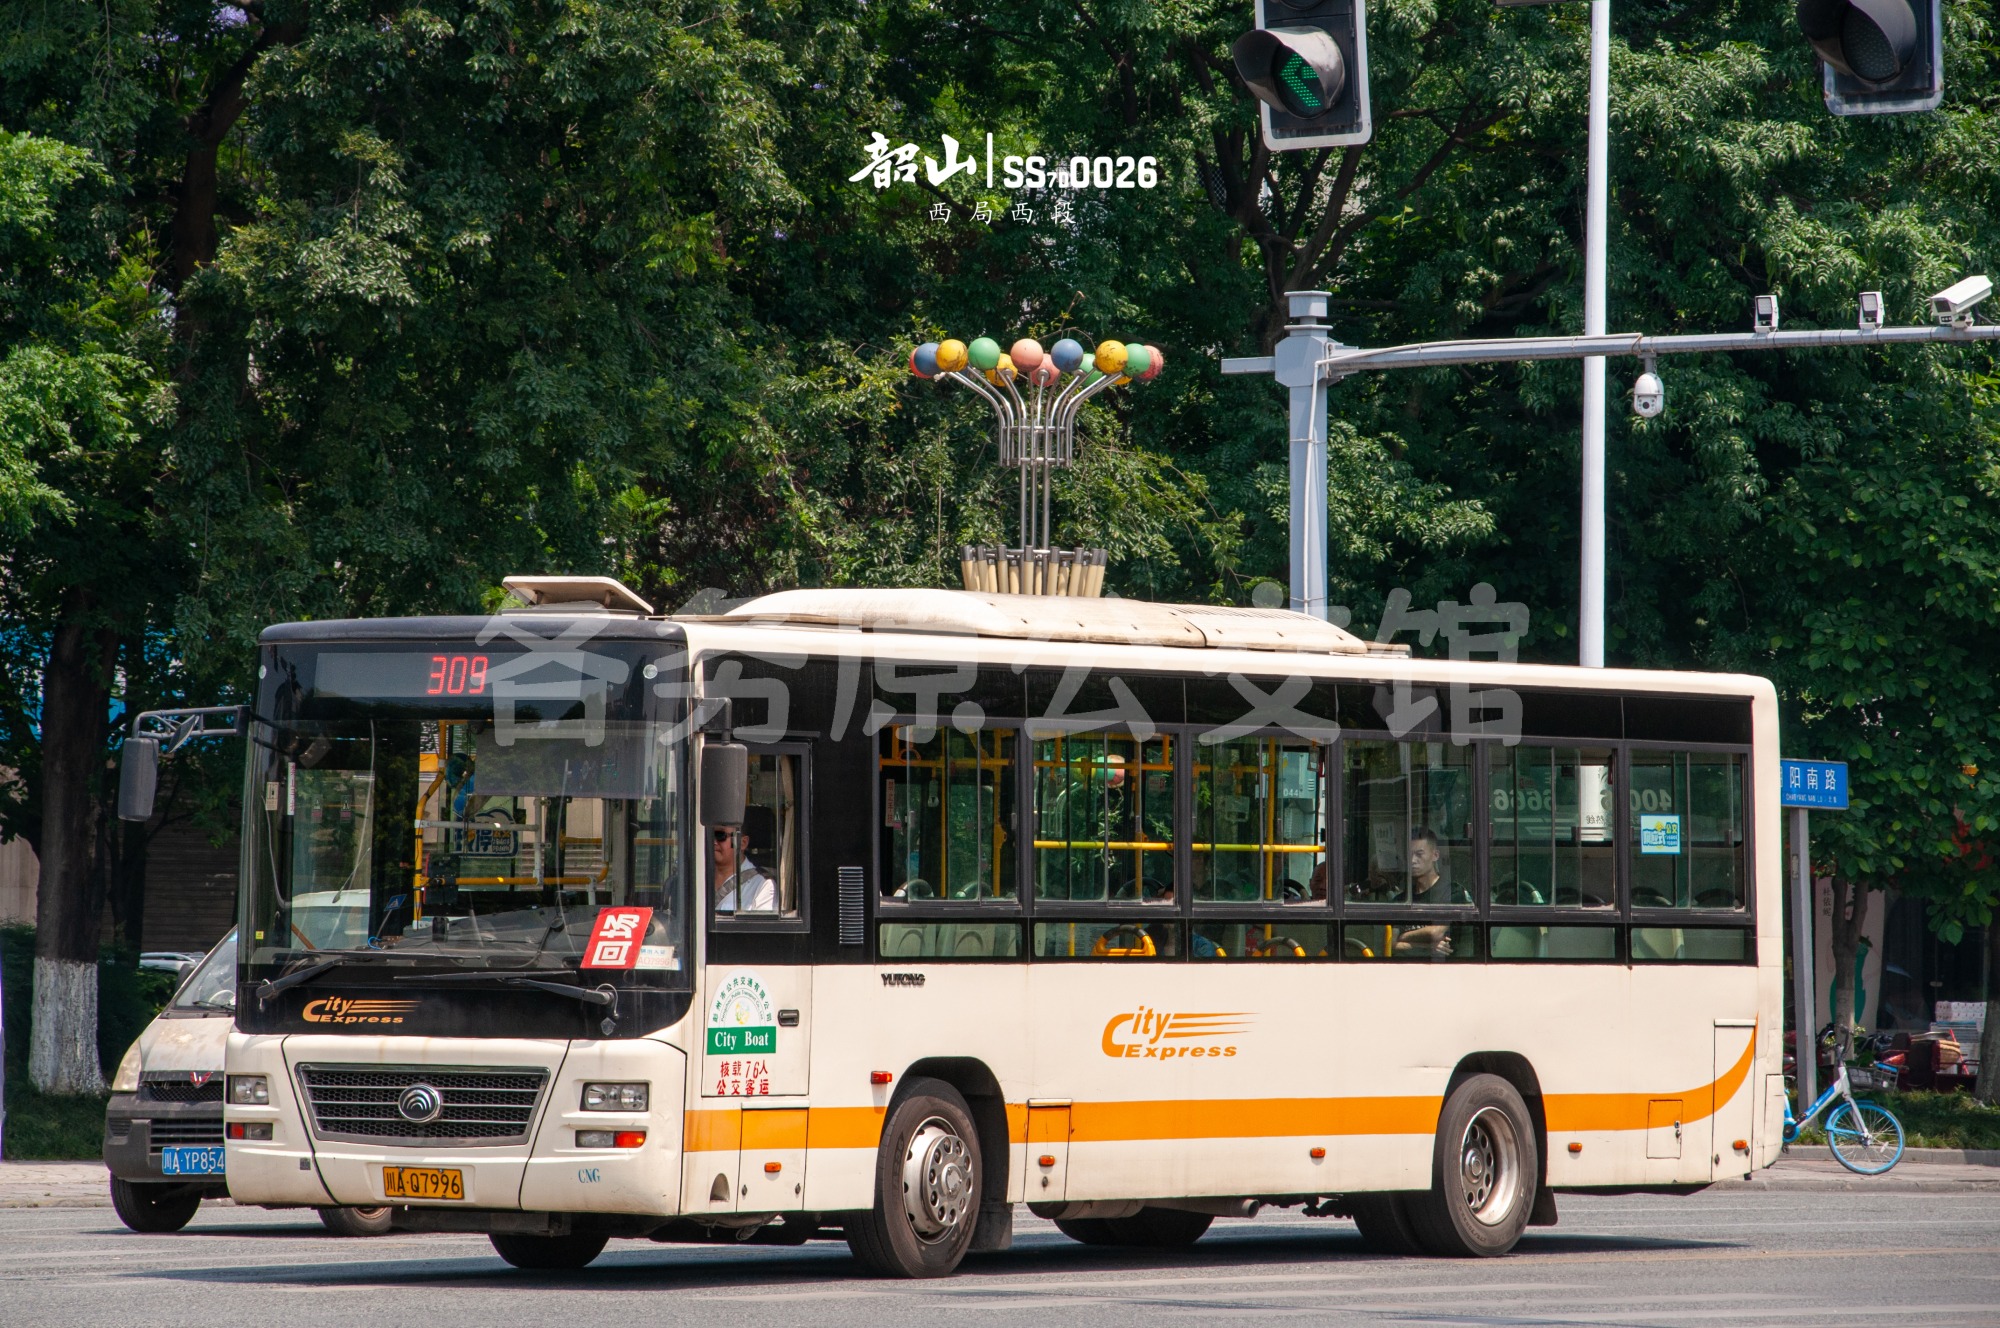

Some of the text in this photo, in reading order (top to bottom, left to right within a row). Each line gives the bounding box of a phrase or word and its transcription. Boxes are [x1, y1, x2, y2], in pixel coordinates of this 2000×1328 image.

[427, 655, 489, 695] 309
[1780, 765, 1837, 791] 阳南路
[881, 973, 926, 987] YUTONG
[302, 996, 354, 1023] City
[319, 1014, 404, 1024] Express
[715, 1030, 769, 1050] City Boat
[1101, 1005, 1171, 1058] City
[1124, 1043, 1237, 1061] Express
[720, 1059, 768, 1079] 核载76人
[716, 1079, 769, 1095] 公交客运
[578, 1167, 601, 1183] CNG
